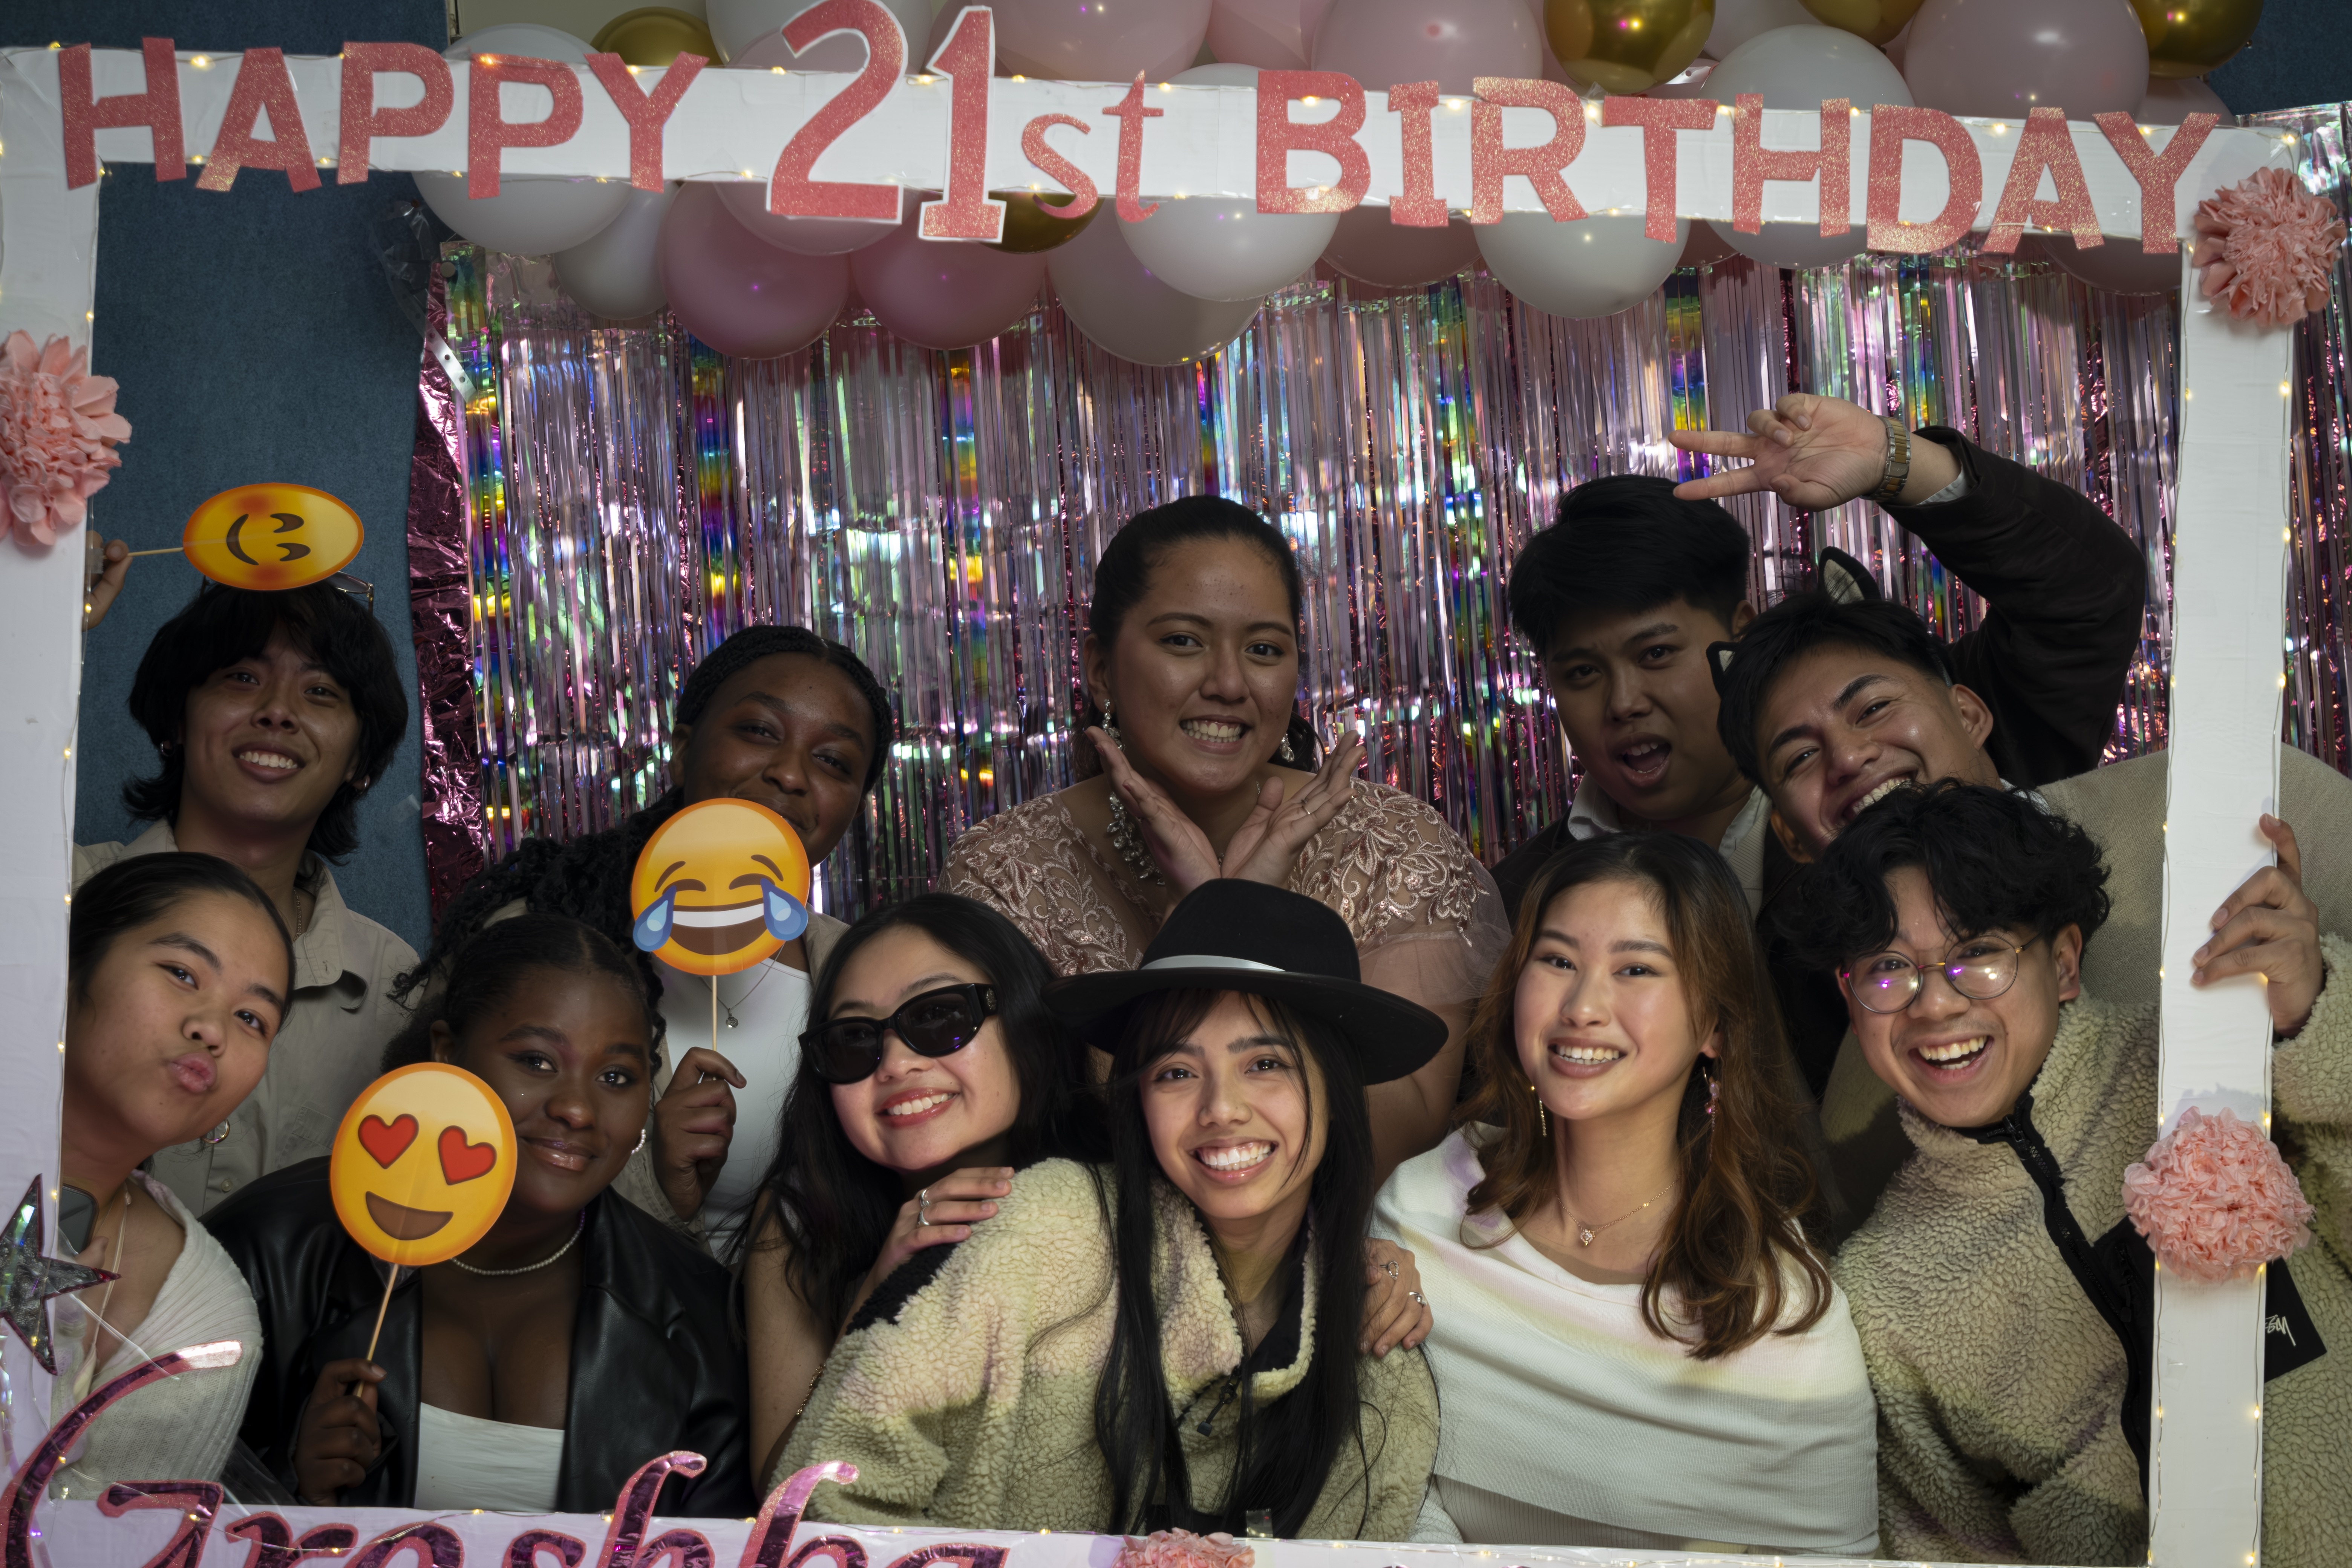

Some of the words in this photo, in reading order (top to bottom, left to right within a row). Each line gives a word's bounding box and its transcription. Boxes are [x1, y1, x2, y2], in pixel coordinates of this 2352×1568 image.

[58, 37, 709, 199] HAPPY
[766, 0, 1164, 242] 21st
[1256, 70, 2220, 253] BIRTHDAY
